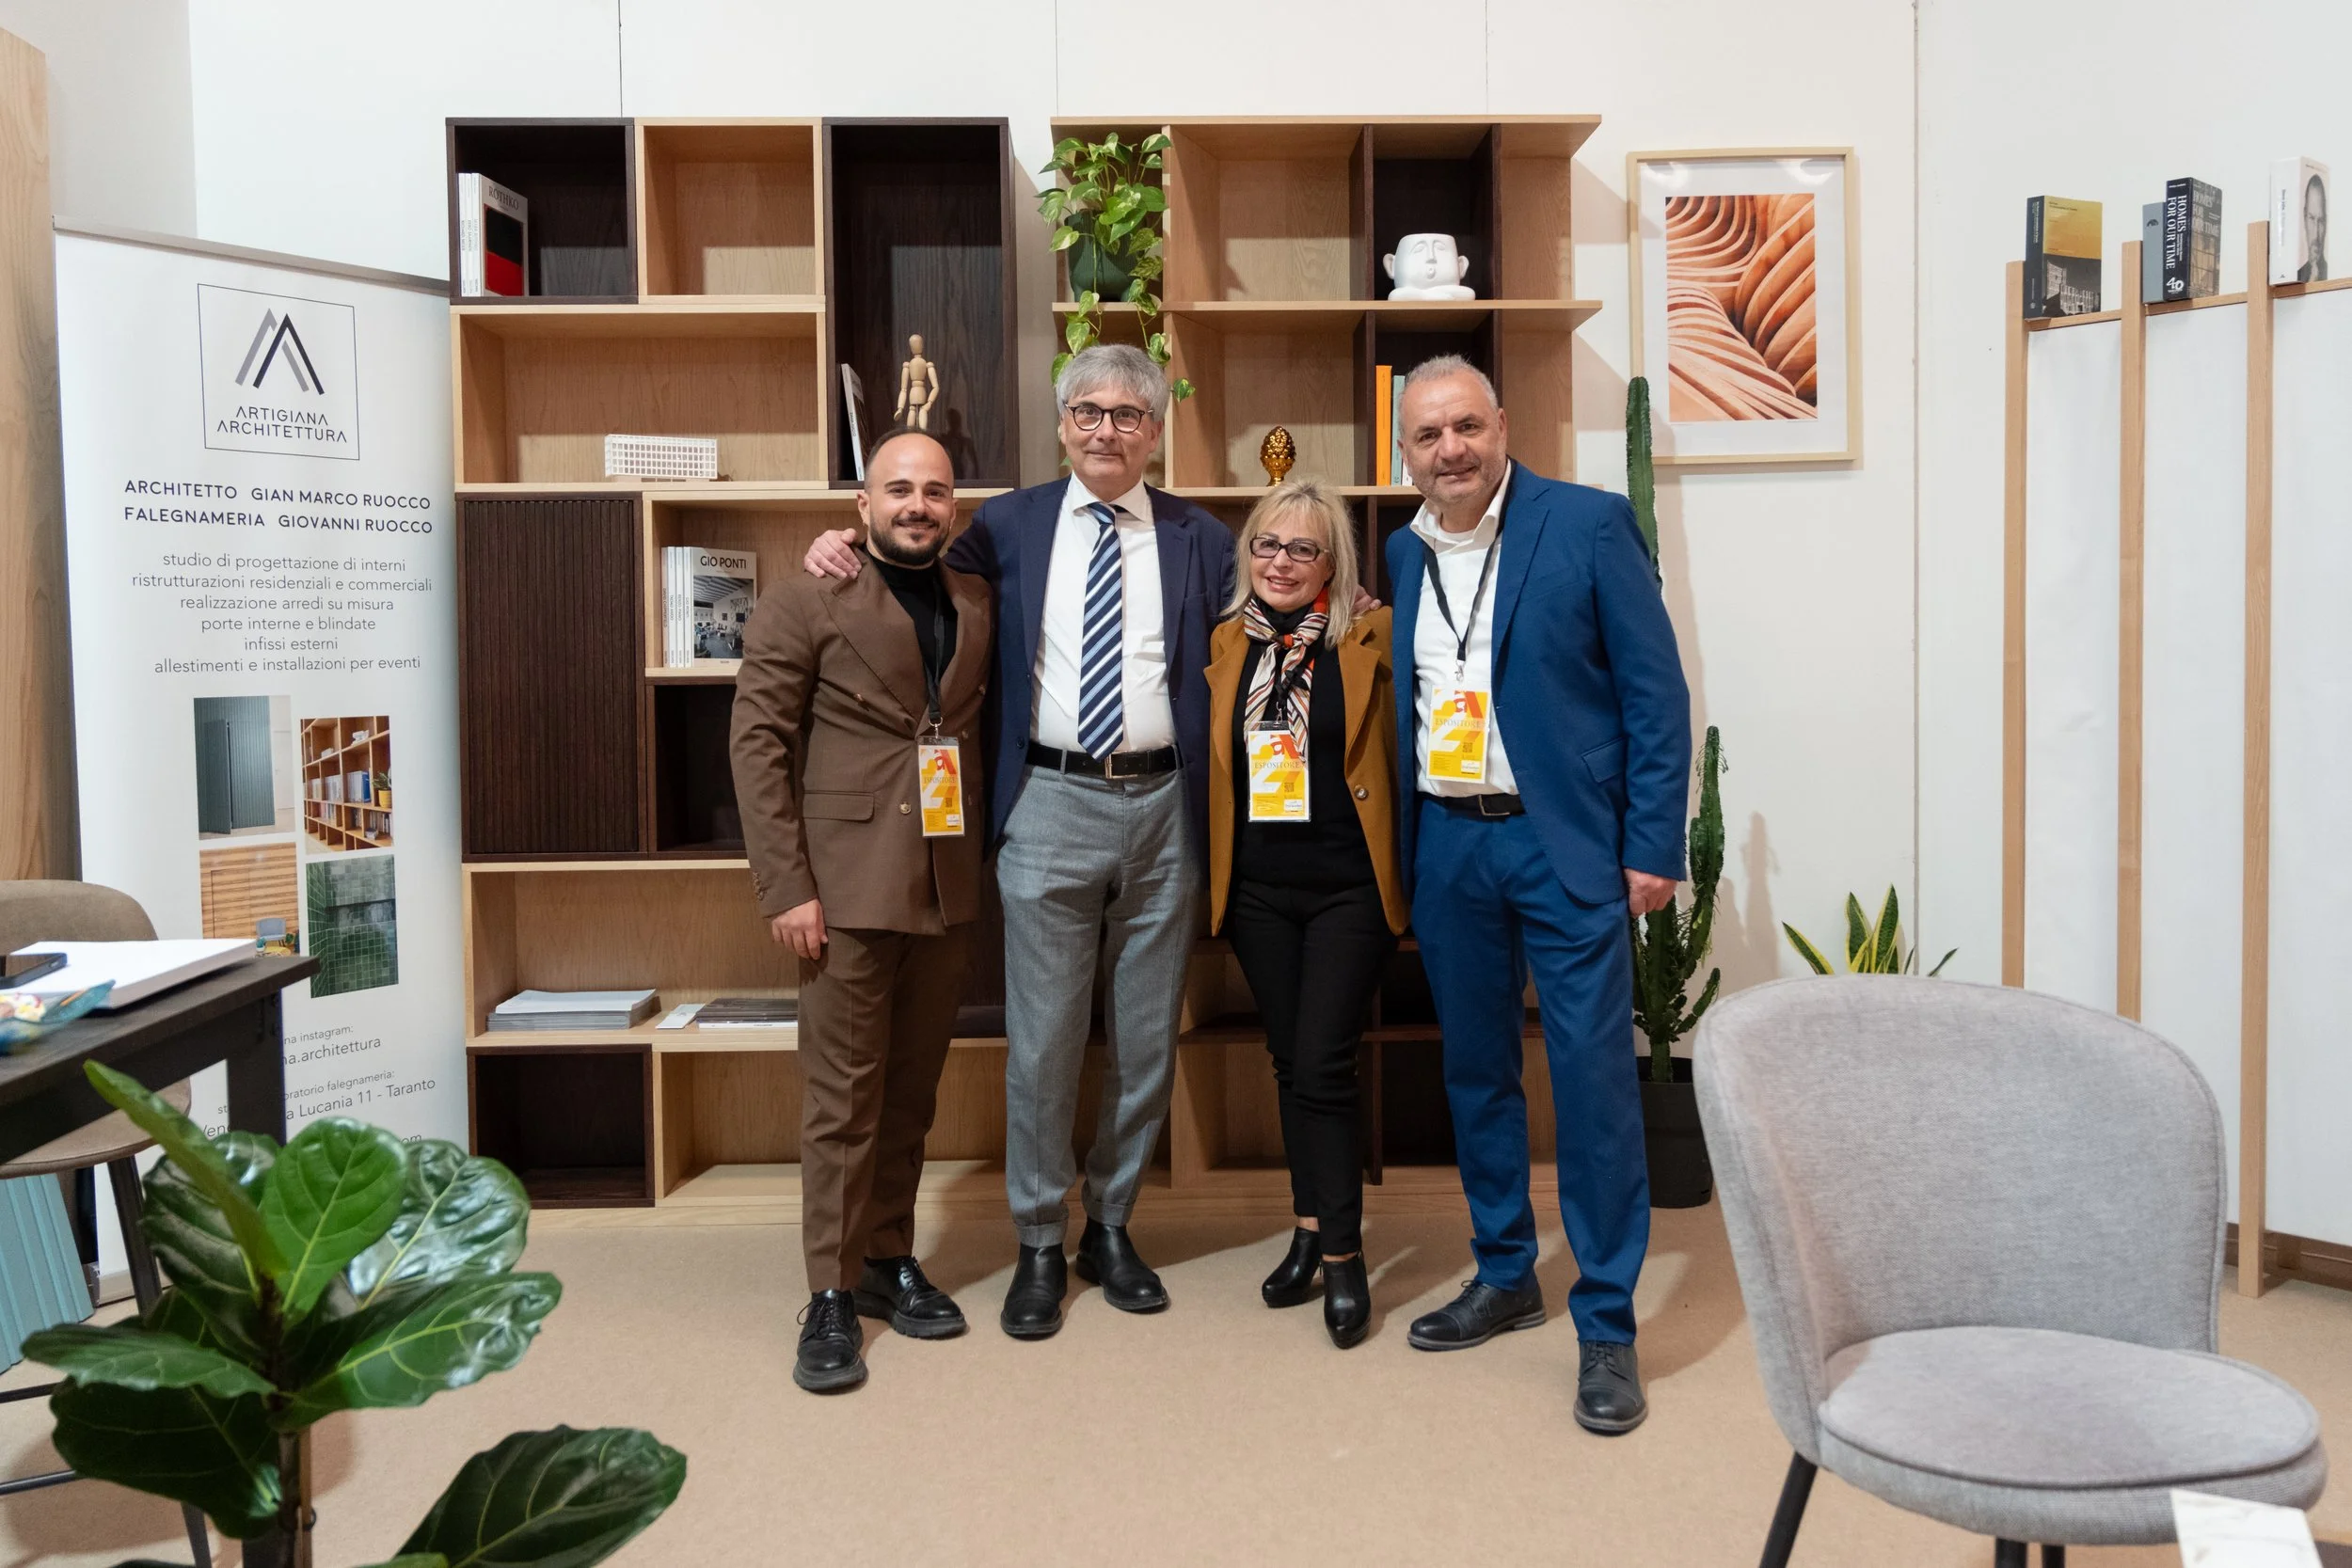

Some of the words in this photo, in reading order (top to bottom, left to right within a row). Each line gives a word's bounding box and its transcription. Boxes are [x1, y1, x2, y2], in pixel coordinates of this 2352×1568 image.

[488, 185, 519, 211] ROTHKO
[2167, 197, 2177, 217] FOR
[2177, 195, 2186, 232] HOMES
[2167, 219, 2176, 242] OUR
[2166, 243, 2175, 270] TIME
[234, 406, 328, 426] ARTIGIANA
[216, 420, 347, 443] ARCHITETTURA
[124, 480, 238, 499] ARCHITETTO
[250, 488, 294, 502] GIAN
[299, 490, 358, 506] MARCO
[362, 494, 431, 510] RUOCCO
[124, 507, 265, 527] FALEGNAMERIA
[278, 515, 360, 531] GIOVANNI
[365, 519, 433, 534] RUOCCO
[162, 552, 213, 567] studio
[216, 553, 230, 567] di
[235, 557, 340, 573] progettazione
[342, 557, 357, 571] di
[360, 559, 405, 572] interni
[700, 555, 718, 567] GIO
[719, 557, 747, 569] PONTI
[132, 573, 245, 589] ristrutturazioni
[249, 575, 331, 591] residenziali
[335, 580, 344, 591] e
[347, 578, 432, 592] commerciali
[180, 594, 278, 610] realizzazione
[281, 596, 324, 610] arredi
[327, 601, 343, 610] su
[348, 597, 393, 610] misura
[201, 619, 244, 634] porte
[247, 617, 301, 630] interne
[305, 621, 314, 630] e
[318, 616, 376, 630] blindate
[244, 636, 286, 651] infissi
[290, 637, 339, 651] esterni
[154, 658, 244, 673] allestimenti
[247, 662, 258, 672] e
[262, 657, 346, 672] installazioni
[350, 660, 374, 673] per
[377, 657, 421, 670] eventi
[1435, 718, 1482, 729] ESPOSITORE
[300, 1025, 354, 1042] instagram:
[326, 1070, 395, 1092] falegnameria:
[299, 1098, 353, 1117] Lucania
[358, 1089, 372, 1104] 11
[385, 1080, 437, 1098] Taranto
